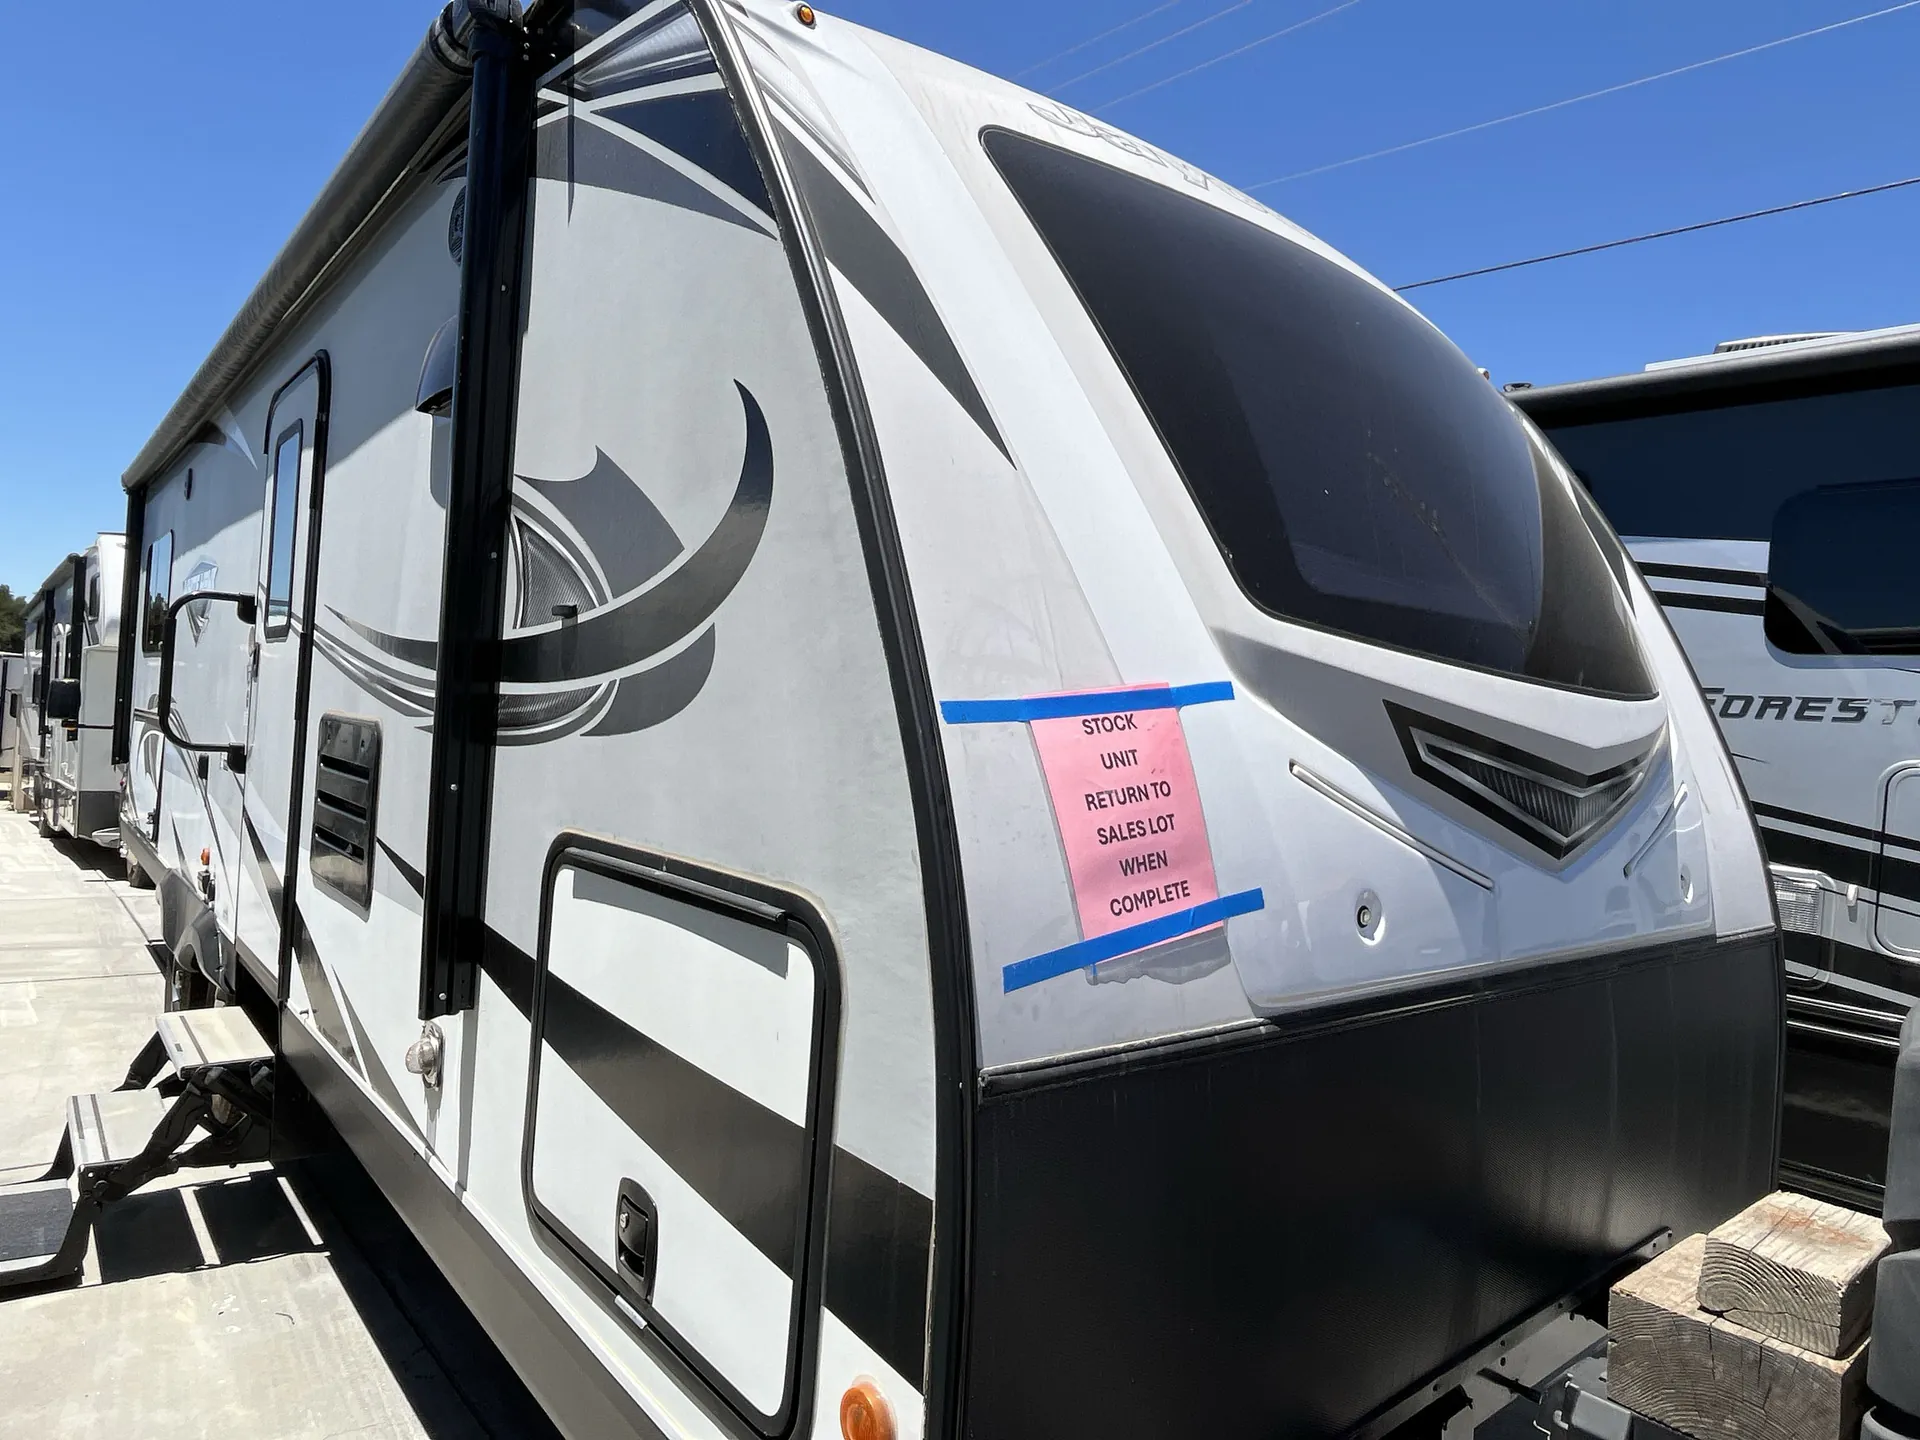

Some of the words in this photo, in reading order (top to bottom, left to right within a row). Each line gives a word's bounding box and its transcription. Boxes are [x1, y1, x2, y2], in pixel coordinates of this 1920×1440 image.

[1702, 687, 1920, 726] FOREST
[1082, 713, 1138, 736] STOCK
[1100, 749, 1138, 770] UNIT
[1084, 784, 1150, 811] RETURN
[1150, 780, 1171, 799] TO
[1096, 820, 1147, 845] SALES
[1149, 813, 1176, 835] LOT
[1119, 850, 1168, 877] WHEN
[1110, 880, 1190, 917] COMPLETE
